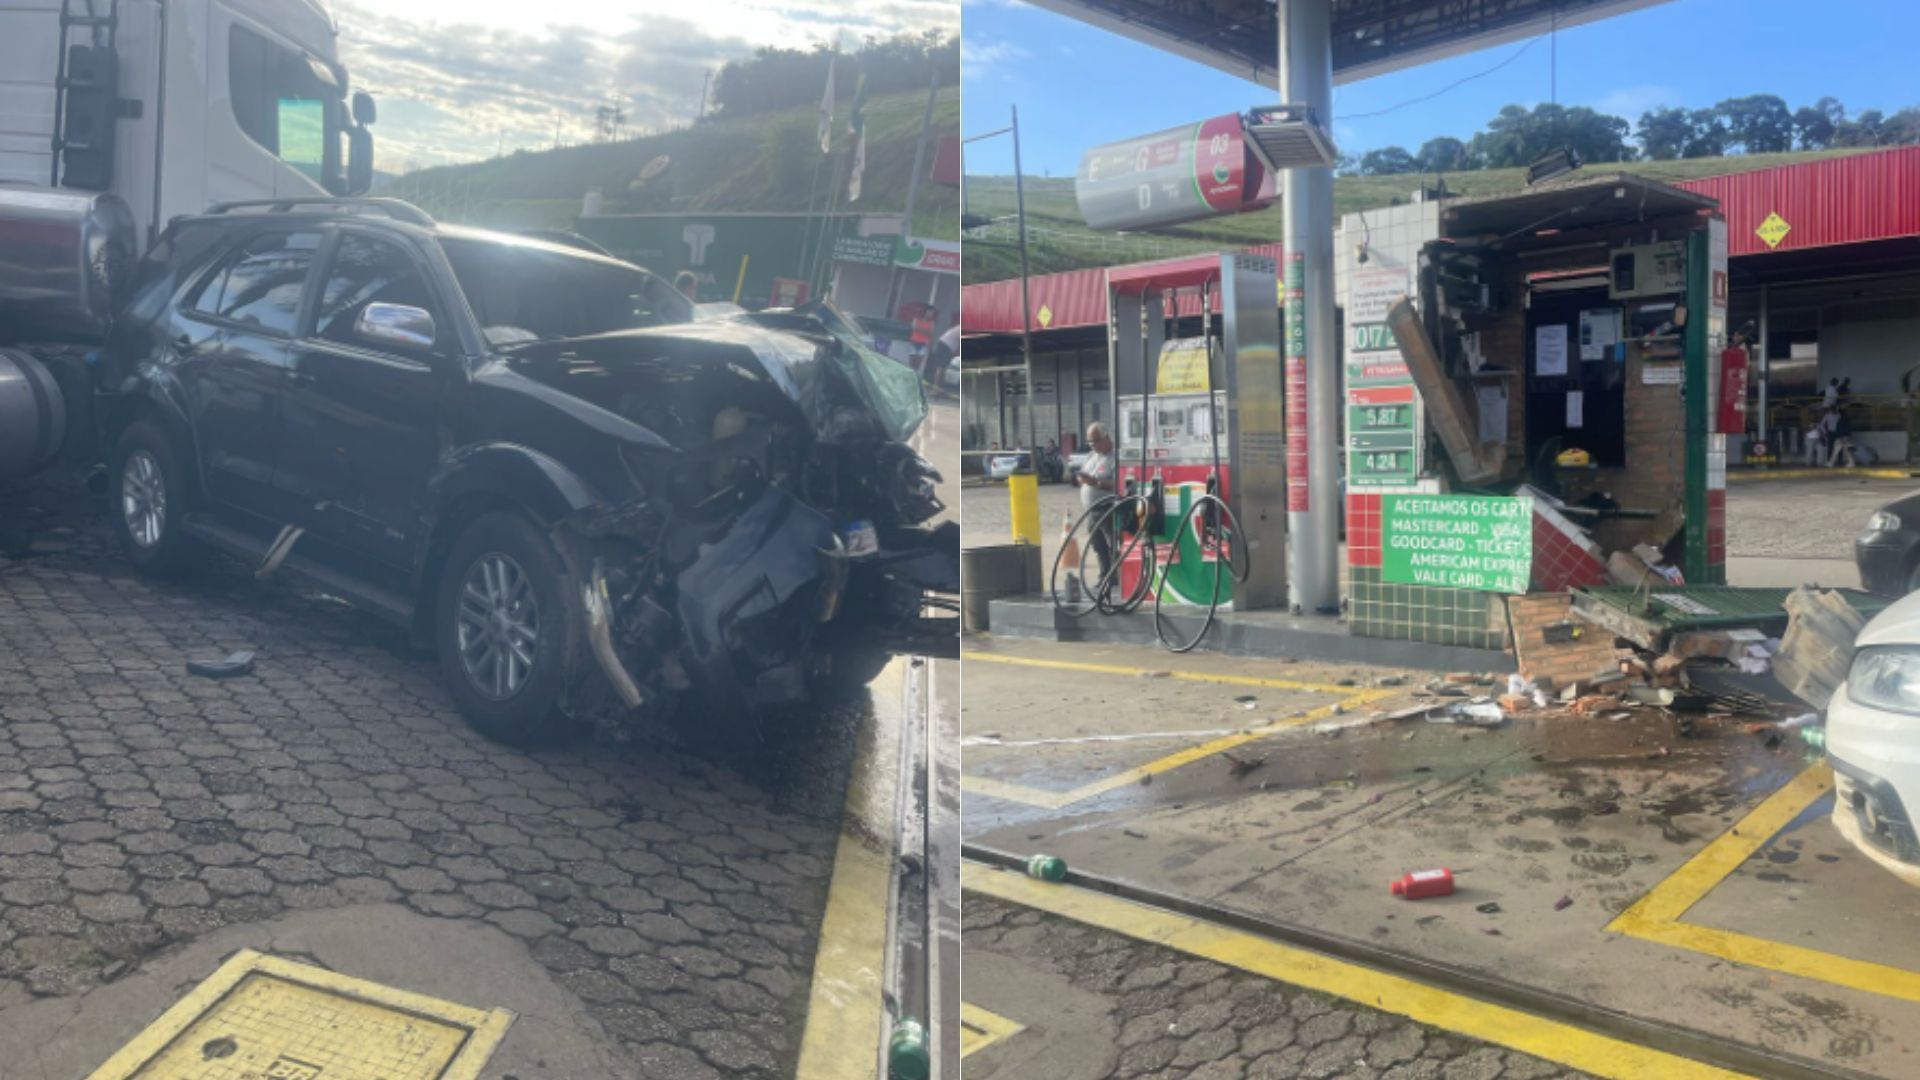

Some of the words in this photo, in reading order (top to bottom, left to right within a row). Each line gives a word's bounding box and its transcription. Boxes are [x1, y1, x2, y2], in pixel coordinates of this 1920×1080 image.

[1210, 134, 1230, 155] 03
[1394, 499, 1468, 516] ACEITAMOS
[1471, 501, 1489, 516] OS
[1391, 519, 1479, 535] MASTERCARD
[1391, 535, 1465, 552] GOODCARD
[1476, 539, 1521, 554] TICKET
[1410, 553, 1481, 569] AMERICAN
[1413, 569, 1446, 584] VALE
[1449, 572, 1485, 587] CARD
